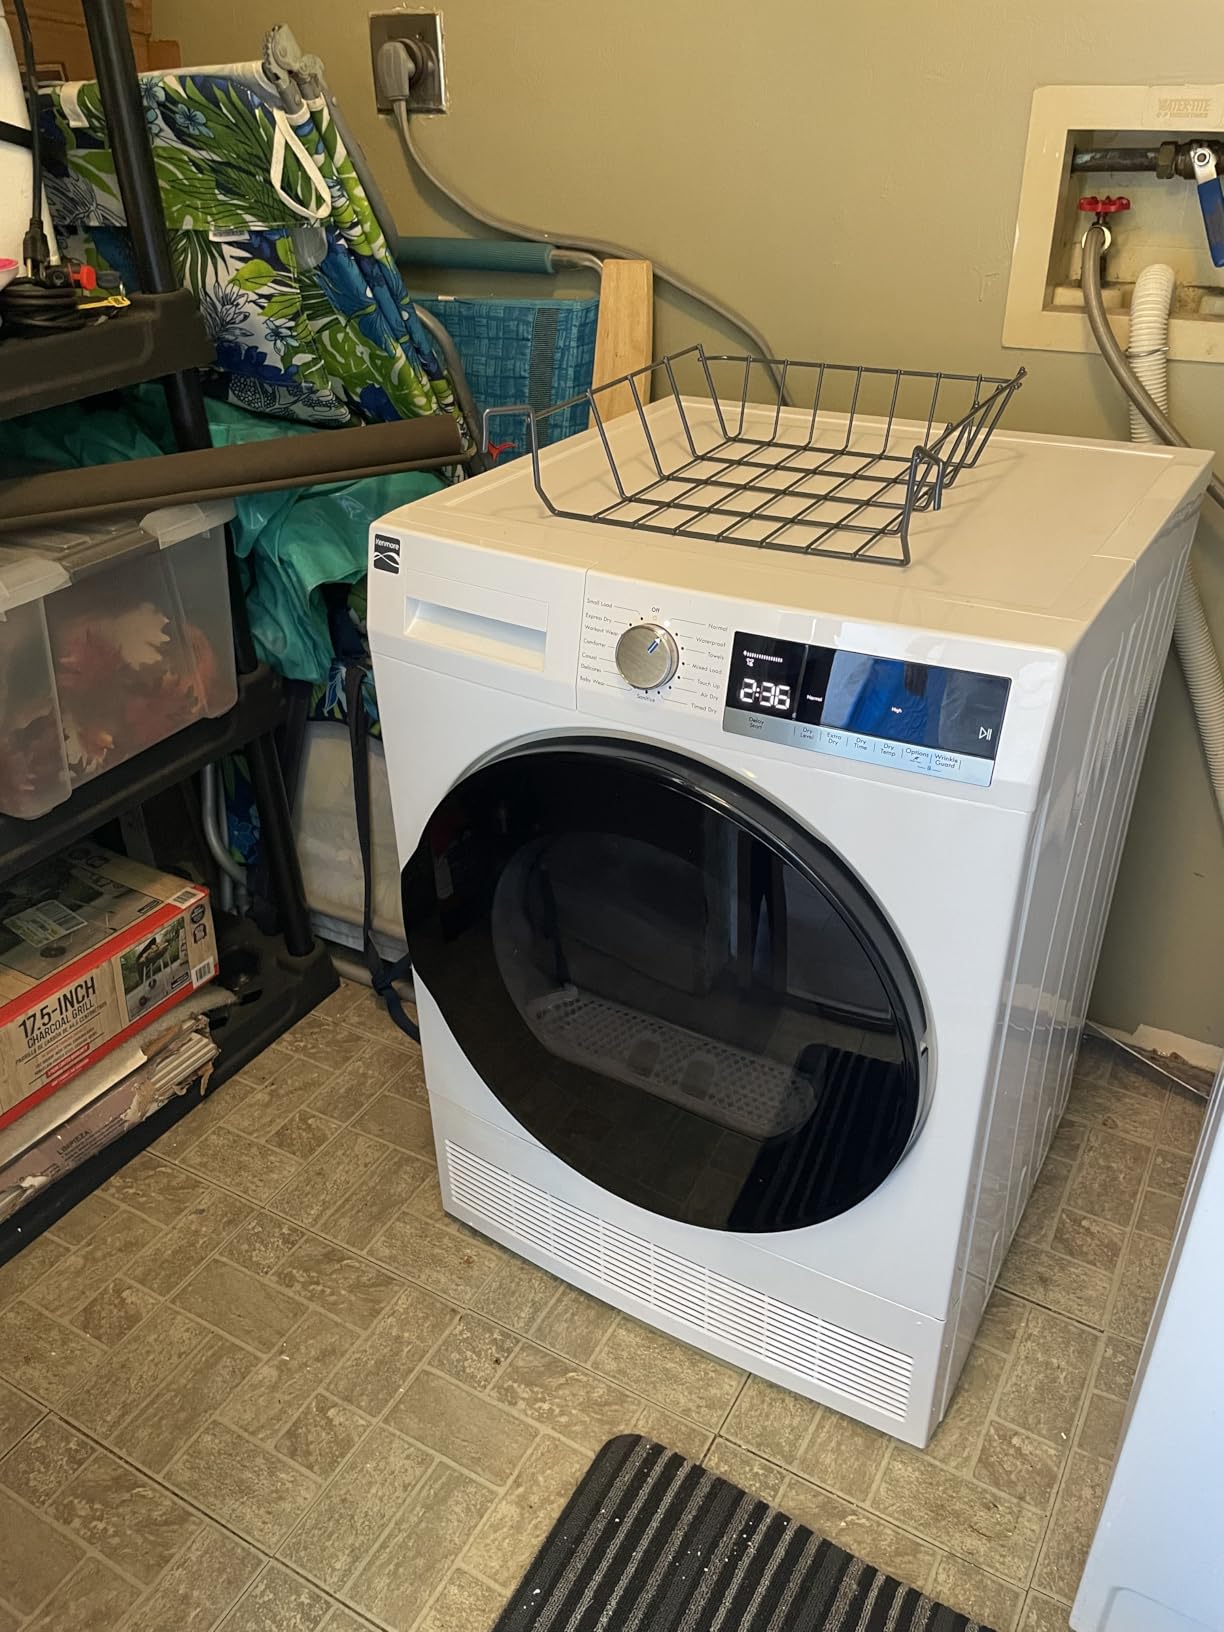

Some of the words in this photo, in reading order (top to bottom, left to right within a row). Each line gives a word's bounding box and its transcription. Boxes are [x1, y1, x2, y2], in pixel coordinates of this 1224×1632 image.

[375, 538, 400, 551] Kenmore
[600, 599, 613, 609] Load
[585, 612, 602, 622] Express
[603, 616, 612, 624] Dry
[708, 623, 728, 632] Normal
[695, 636, 726, 648] Waterproof
[707, 651, 724, 661] Towels
[691, 663, 708, 672] Mixed
[709, 667, 722, 675] Load
[697, 679, 711, 687] Touch
[712, 682, 721, 690] Up
[740, 678, 791, 710] 2:36
[691, 702, 707, 711] Timed
[707, 706, 717, 715] Dry
[748, 716, 765, 725] Delay
[802, 727, 813, 735] Dry
[827, 732, 842, 740] Extra
[828, 738, 839, 746] Dry
[856, 737, 867, 745] Dry
[853, 743, 868, 751] Time
[883, 743, 895, 751] Dry
[880, 748, 896, 757] Temp
[905, 747, 930, 758] Options
[934, 753, 959, 764] Wrinkle
[935, 760, 956, 769] Guard
[18, 976, 97, 1039] 17.5-INCH
[26, 1015, 70, 1049] CHARCOAL
[71, 998, 95, 1019] GRILL
